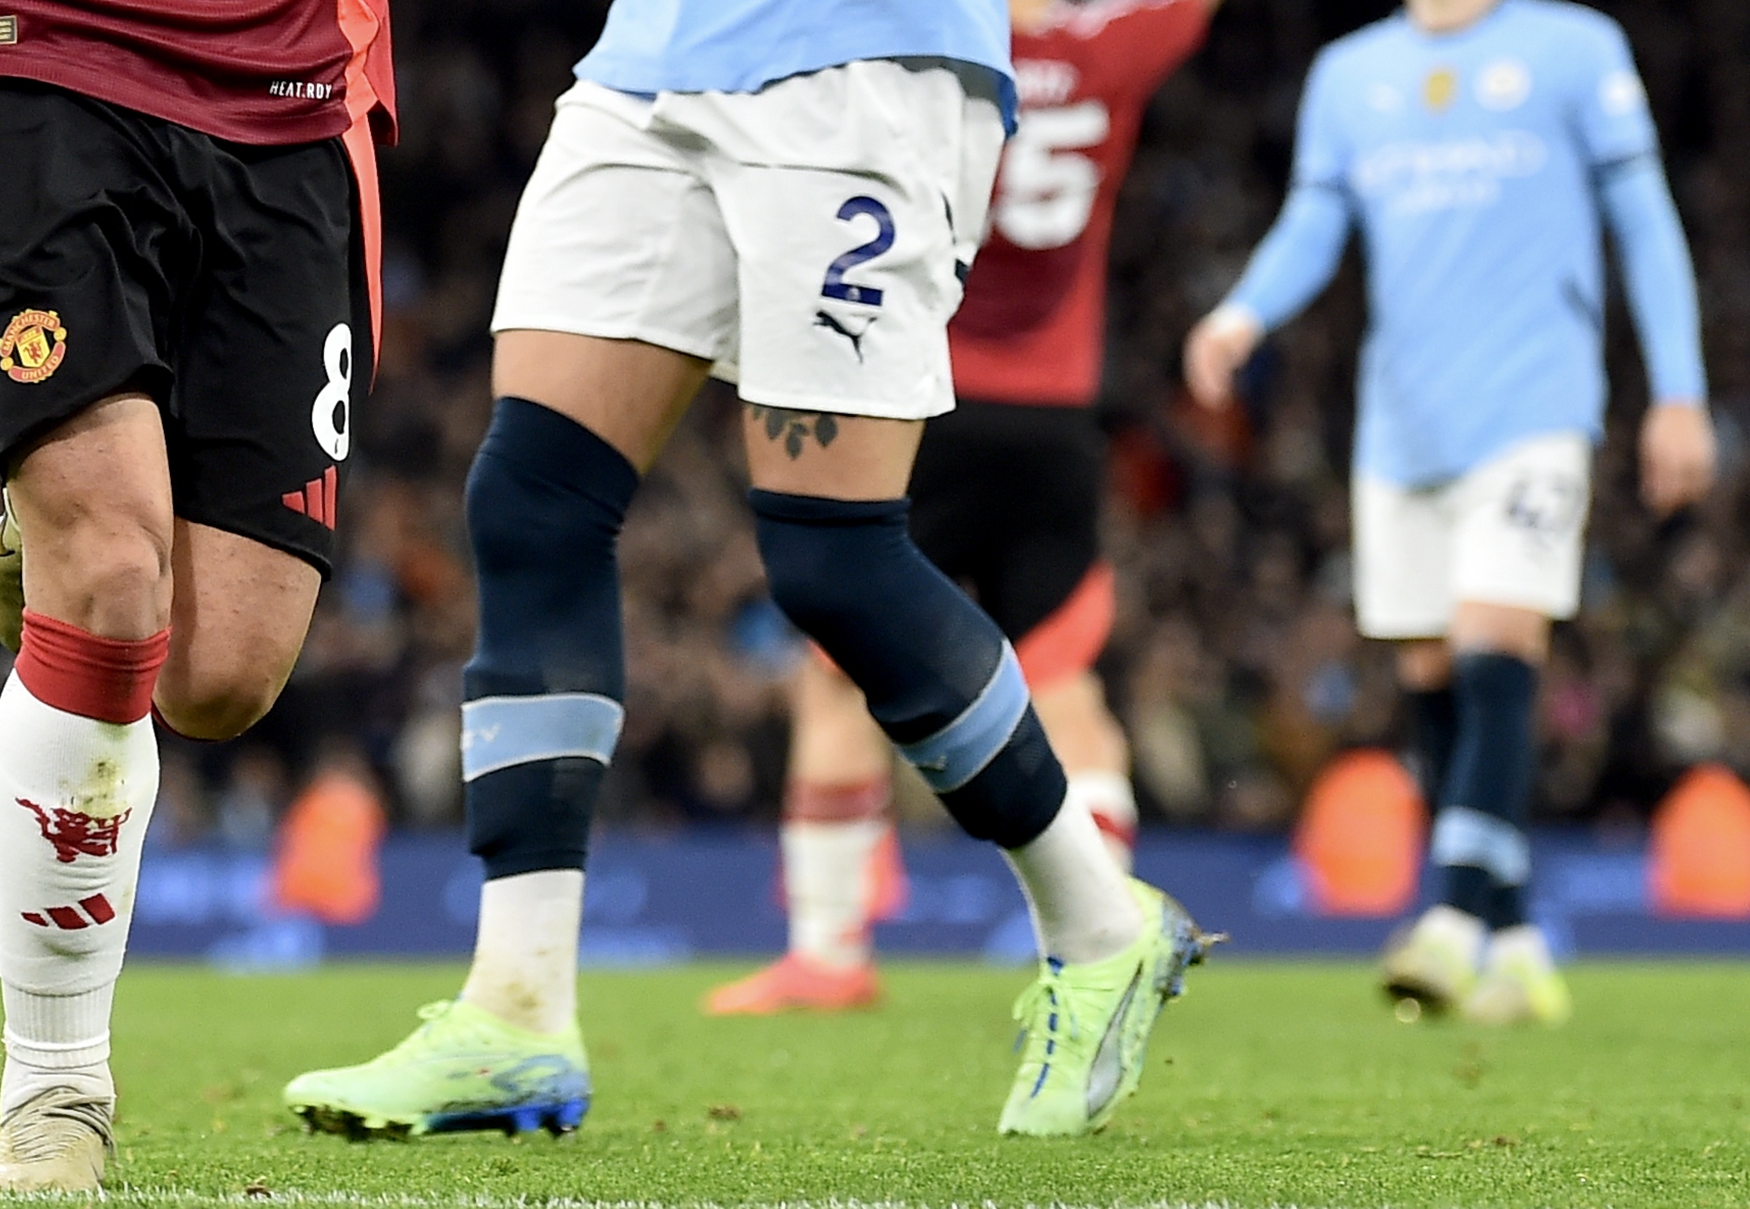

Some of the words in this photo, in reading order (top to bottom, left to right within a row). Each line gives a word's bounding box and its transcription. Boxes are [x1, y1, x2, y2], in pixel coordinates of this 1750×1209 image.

[269, 80, 332, 100] HEAT.RDY
[997, 101, 1110, 251] 5
[821, 195, 896, 307] 2
[3, 313, 57, 351] MANCHESTER
[21, 355, 59, 380] UNITED
[311, 322, 352, 462] 8
